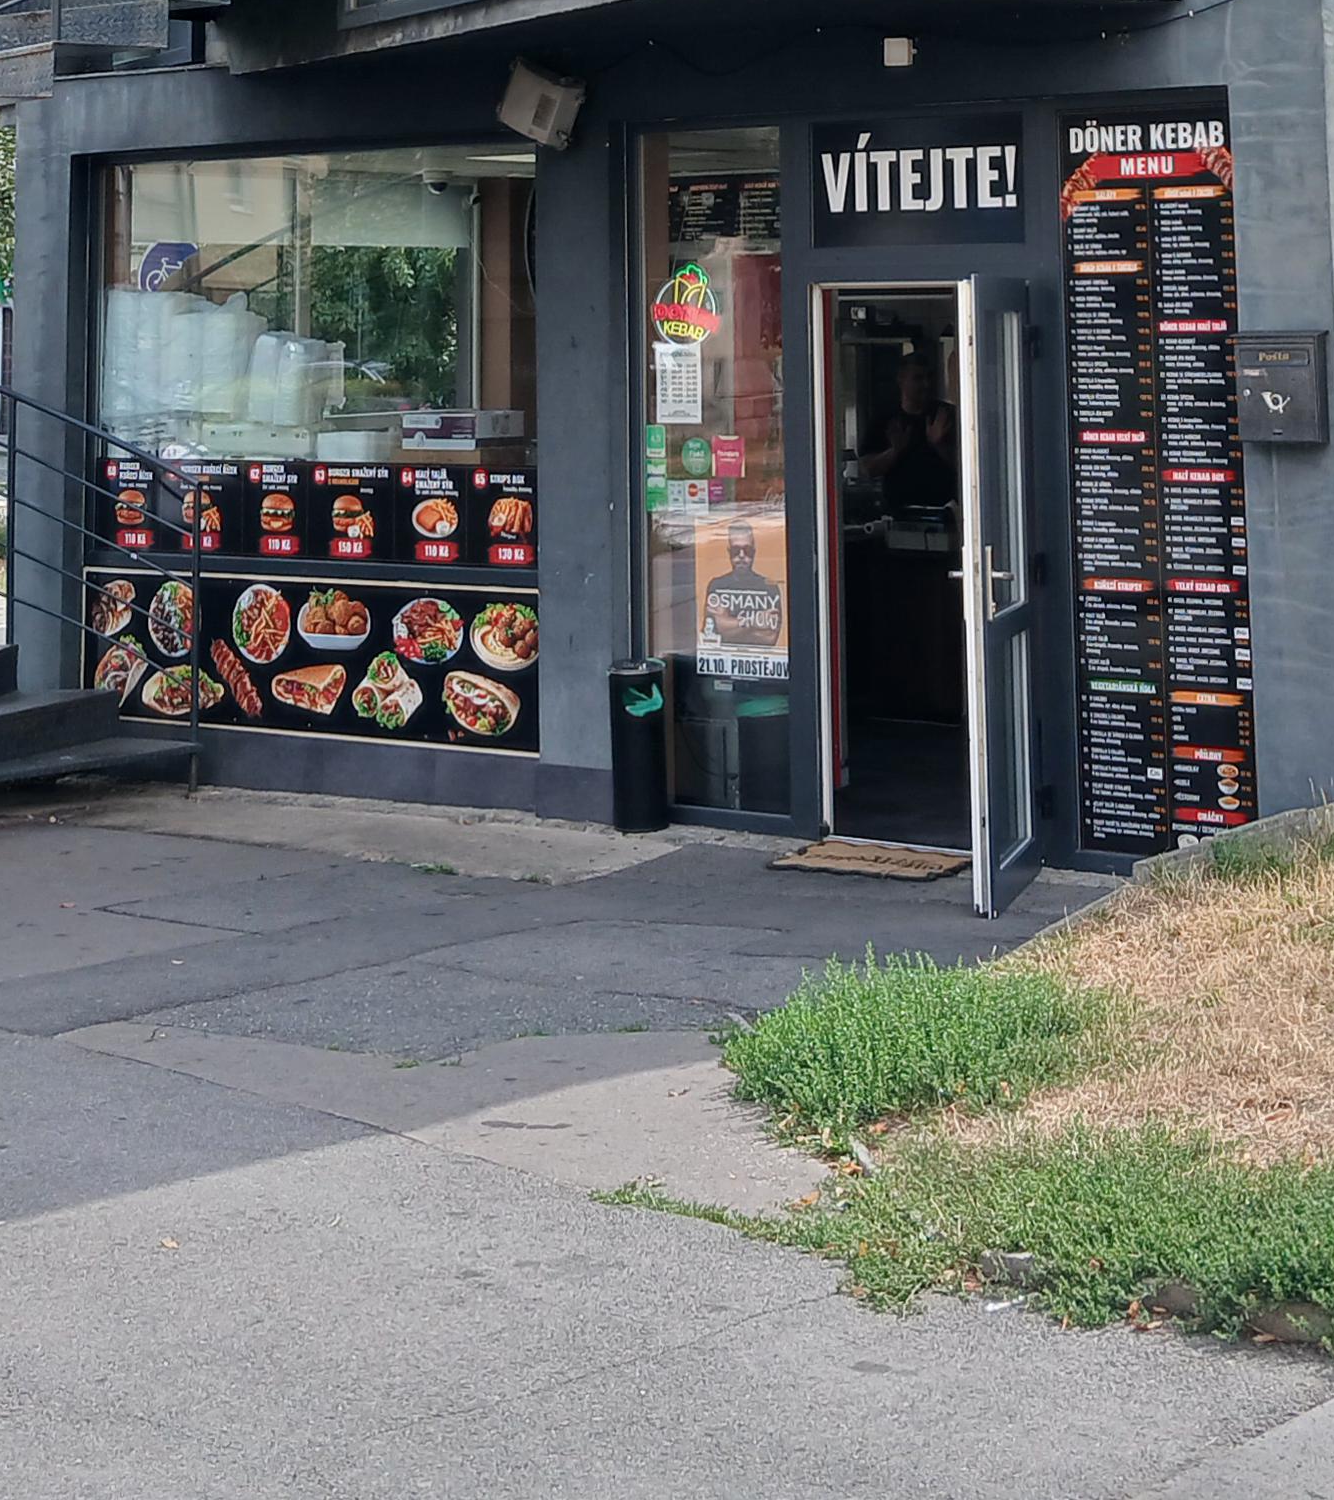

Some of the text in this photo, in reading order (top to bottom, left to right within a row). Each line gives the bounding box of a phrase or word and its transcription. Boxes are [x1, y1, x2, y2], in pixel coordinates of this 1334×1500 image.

[1069, 120, 1225, 154] DÖNER KEBAB
[821, 132, 1017, 213] VÍTEJTE!
[1120, 156, 1174, 176] MENU
[663, 320, 704, 341] KEBAB
[124, 532, 147, 545] 110 Kč
[268, 538, 291, 551] 110 Kč
[338, 541, 363, 554] 150 Kč
[425, 545, 438, 557] 110
[513, 547, 524, 560] Kč
[707, 593, 780, 611] OSMANY
[738, 610, 779, 630] SHOW
[699, 657, 788, 678] 21.10. PROSTĚJOV
